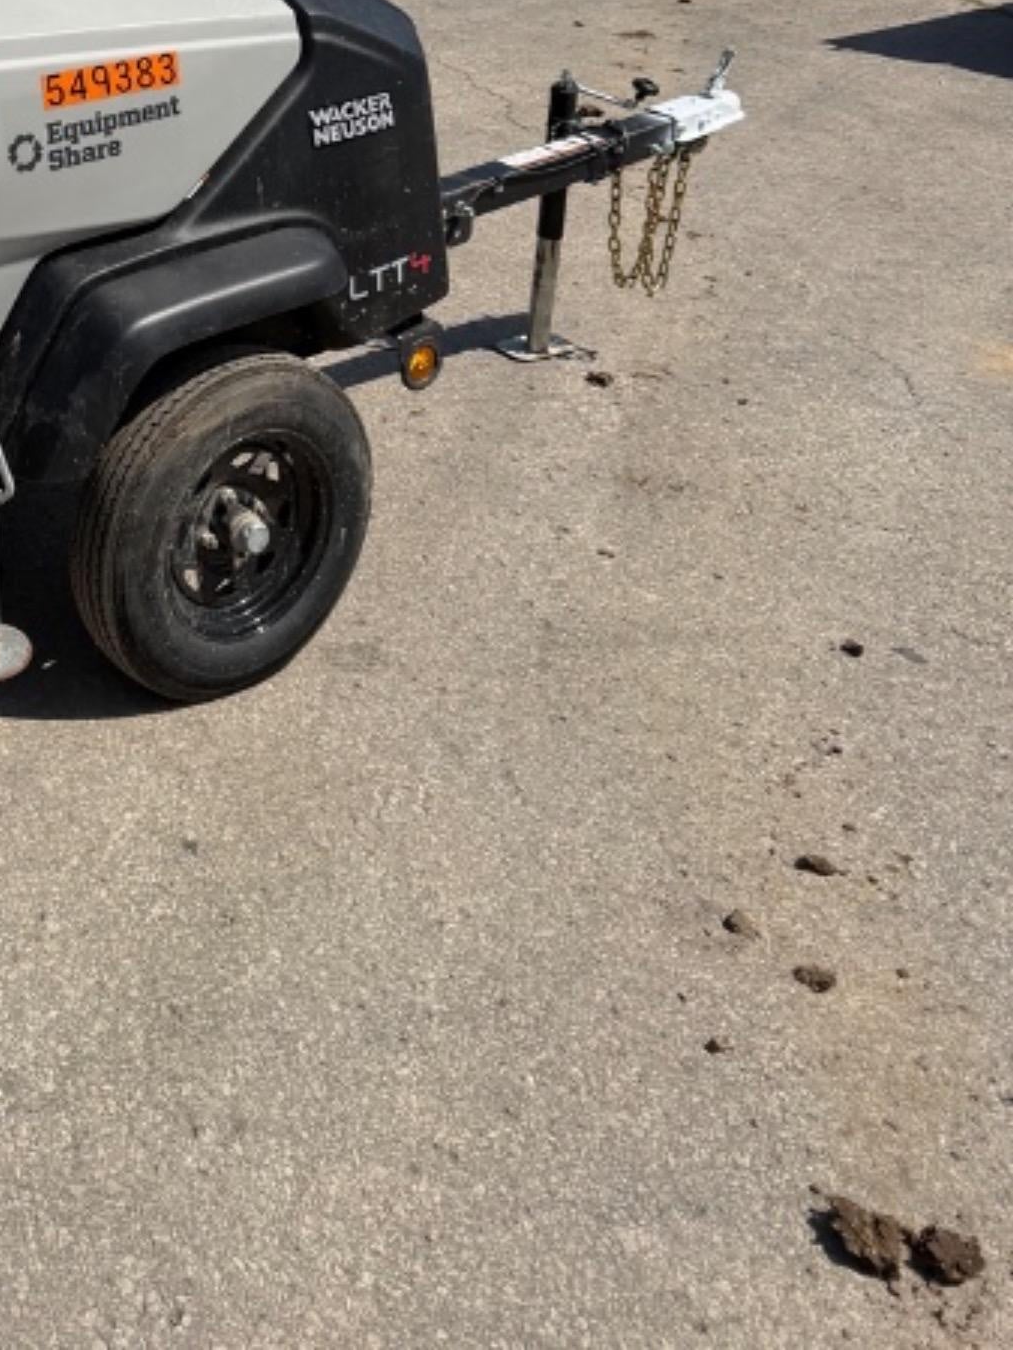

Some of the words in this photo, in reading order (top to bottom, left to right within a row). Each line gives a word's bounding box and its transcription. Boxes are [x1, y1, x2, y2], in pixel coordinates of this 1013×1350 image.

[45, 53, 178, 106] 549383
[46, 96, 180, 145] Equipment
[309, 93, 393, 128] WACKER
[313, 111, 395, 147] NEUSON
[48, 140, 122, 171] Share
[348, 252, 431, 301] LTT4
